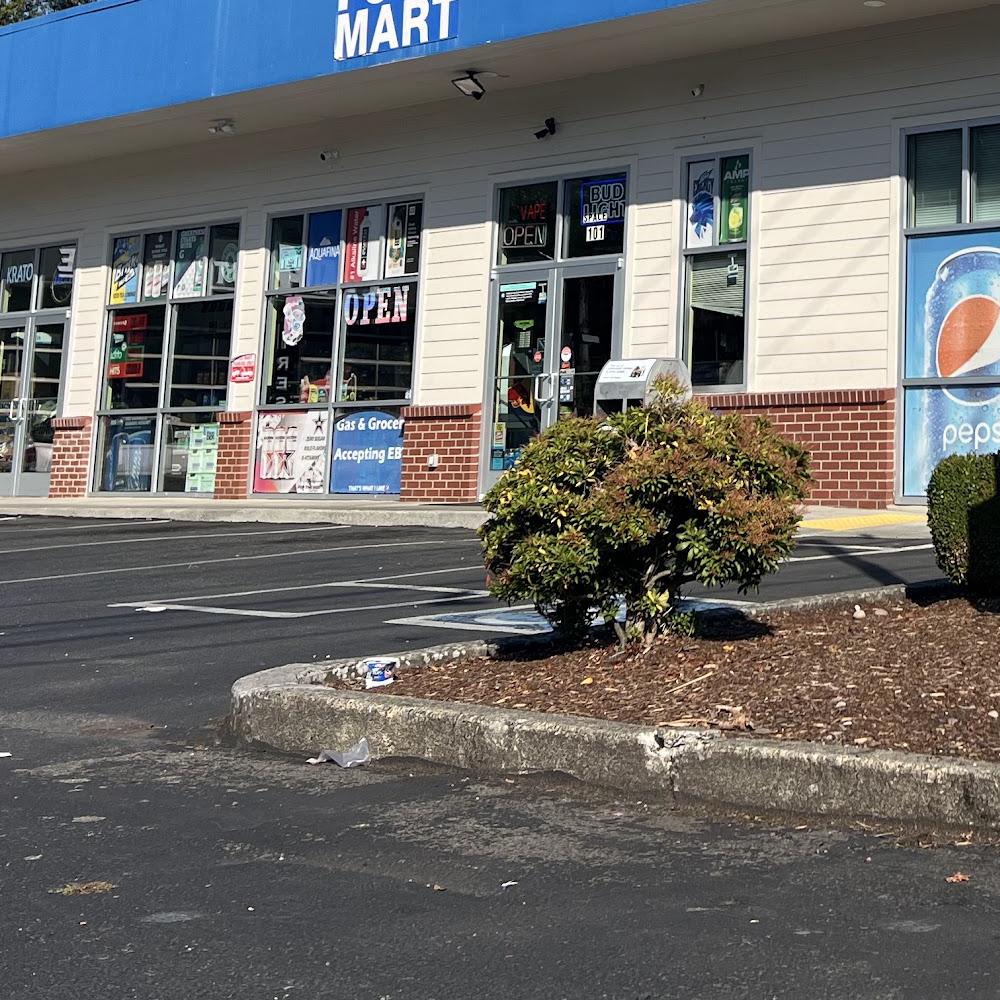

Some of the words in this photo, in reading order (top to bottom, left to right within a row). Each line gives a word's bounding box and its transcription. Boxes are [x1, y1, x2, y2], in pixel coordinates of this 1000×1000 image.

[590, 183, 624, 203] BUD
[520, 203, 546, 220] VAPE
[584, 214, 607, 223] SPACE
[503, 225, 545, 246] OPEN
[588, 227, 604, 240] 101
[308, 245, 340, 262] AQUAFINA
[344, 285, 410, 326] OPEN
[336, 419, 356, 431] Gas
[357, 417, 366, 430] &
[334, 447, 386, 463] Accepting
